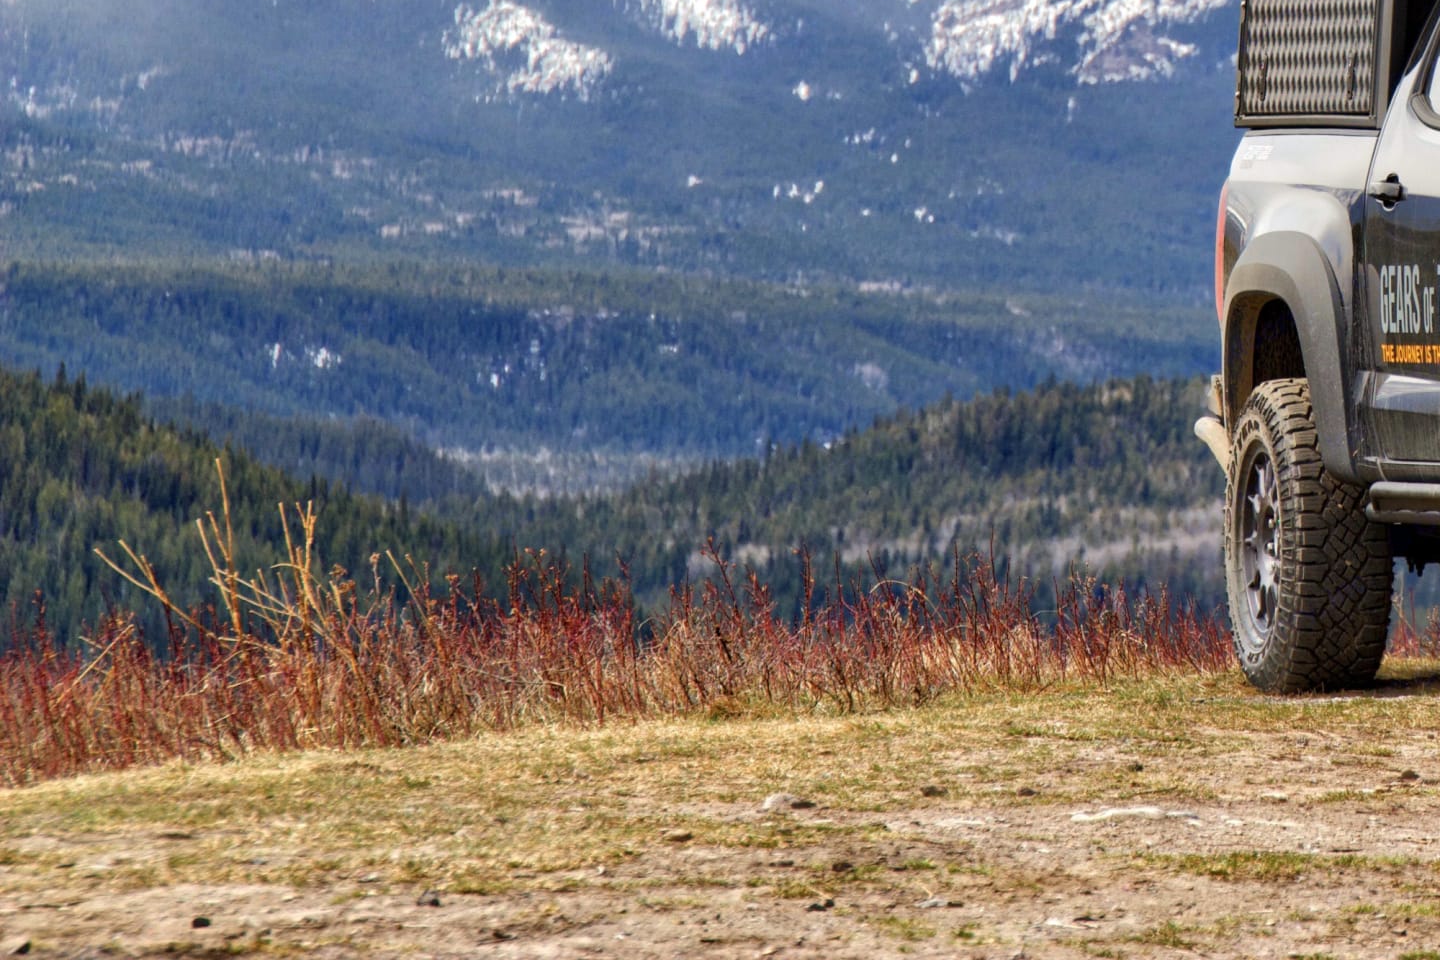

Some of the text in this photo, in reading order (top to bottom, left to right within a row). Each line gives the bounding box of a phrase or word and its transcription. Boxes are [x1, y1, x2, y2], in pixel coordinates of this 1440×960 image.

[1380, 264, 1420, 333] GEARS
[1423, 287, 1435, 333] OF
[1381, 344, 1395, 362] THE
[1395, 344, 1424, 363] JOURNEY
[1425, 345, 1432, 363] IS
